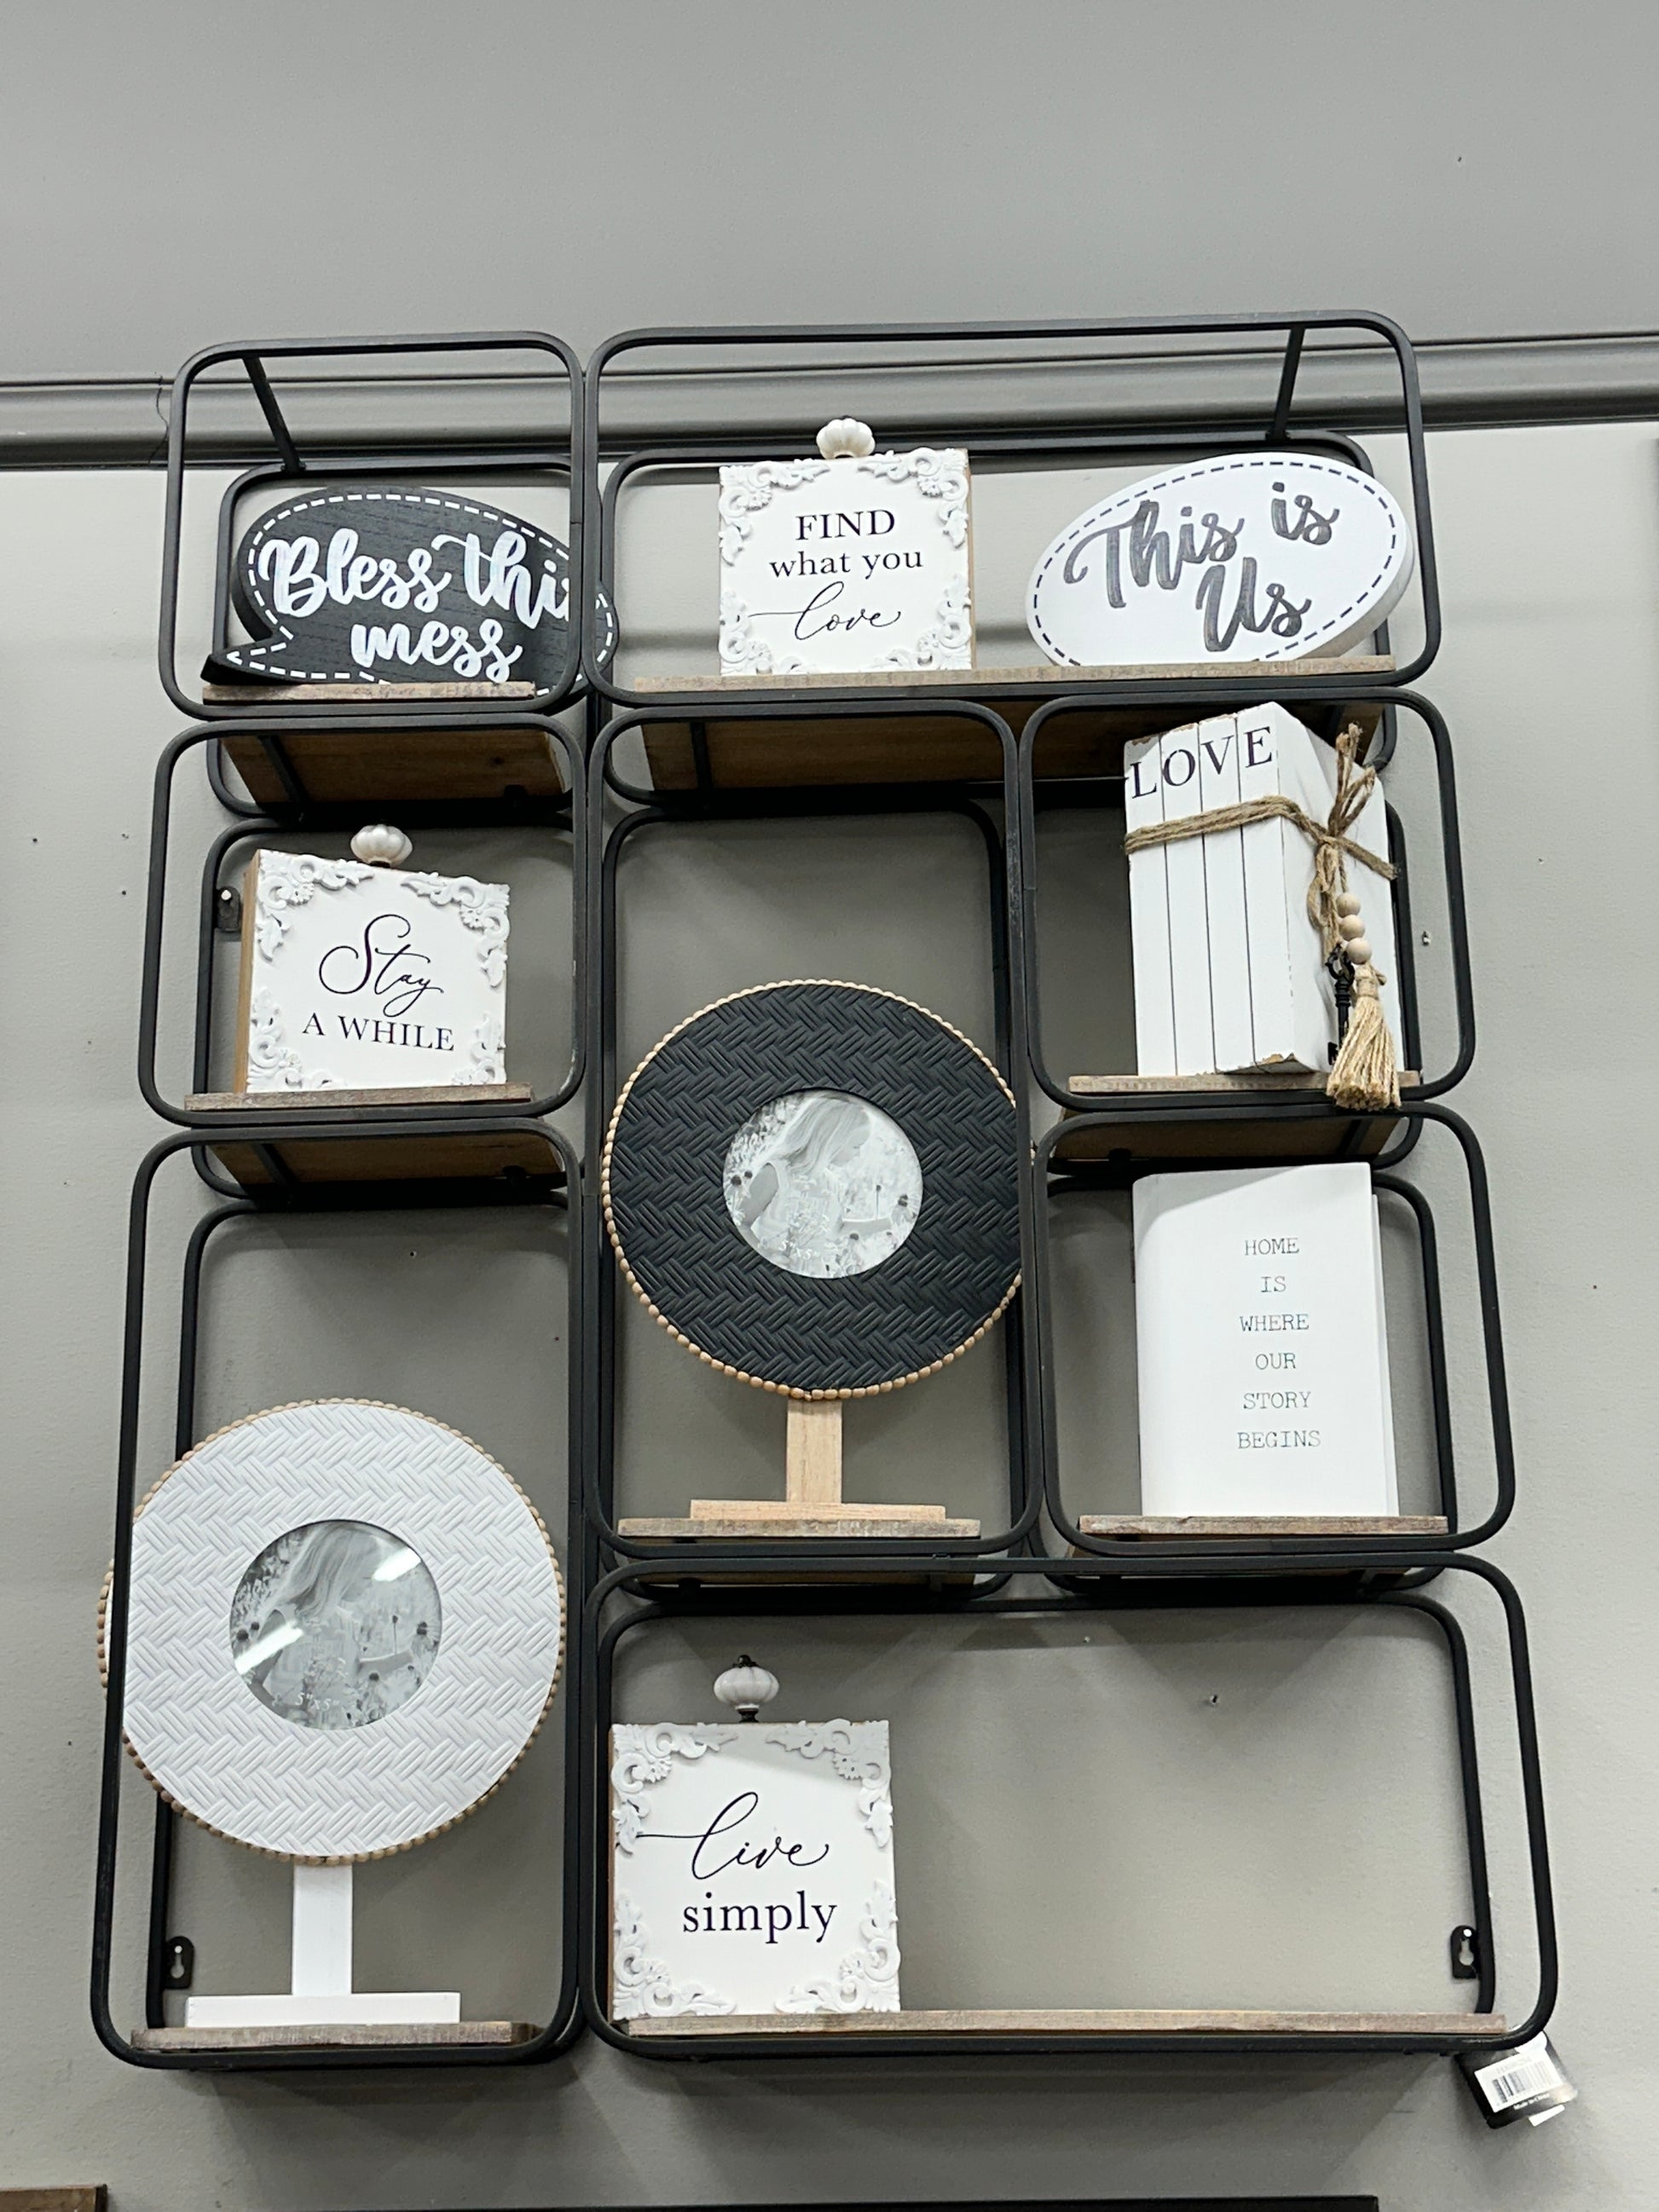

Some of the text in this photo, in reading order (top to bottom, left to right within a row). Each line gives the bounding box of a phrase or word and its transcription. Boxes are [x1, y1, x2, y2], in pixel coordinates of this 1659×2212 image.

[795, 509, 895, 540] FIND
[1063, 481, 1340, 609] This is
[257, 528, 452, 618] Bless
[769, 551, 923, 580] what you
[748, 580, 901, 641] love
[1195, 557, 1312, 652] Us
[350, 618, 523, 684] mess
[1128, 726, 1273, 800] LOVE
[318, 914, 444, 1018] Stay
[302, 1012, 455, 1052] A WHILE
[1244, 1237, 1300, 1256] HOME
[1260, 1275, 1287, 1293] IS
[1239, 1314, 1310, 1332] WHERE
[1255, 1352, 1297, 1371] OUR
[1242, 1391, 1312, 1410] STORY
[1236, 1429, 1321, 1449] BEGINS
[635, 1792, 830, 1880] live
[682, 1890, 838, 1944] simply
